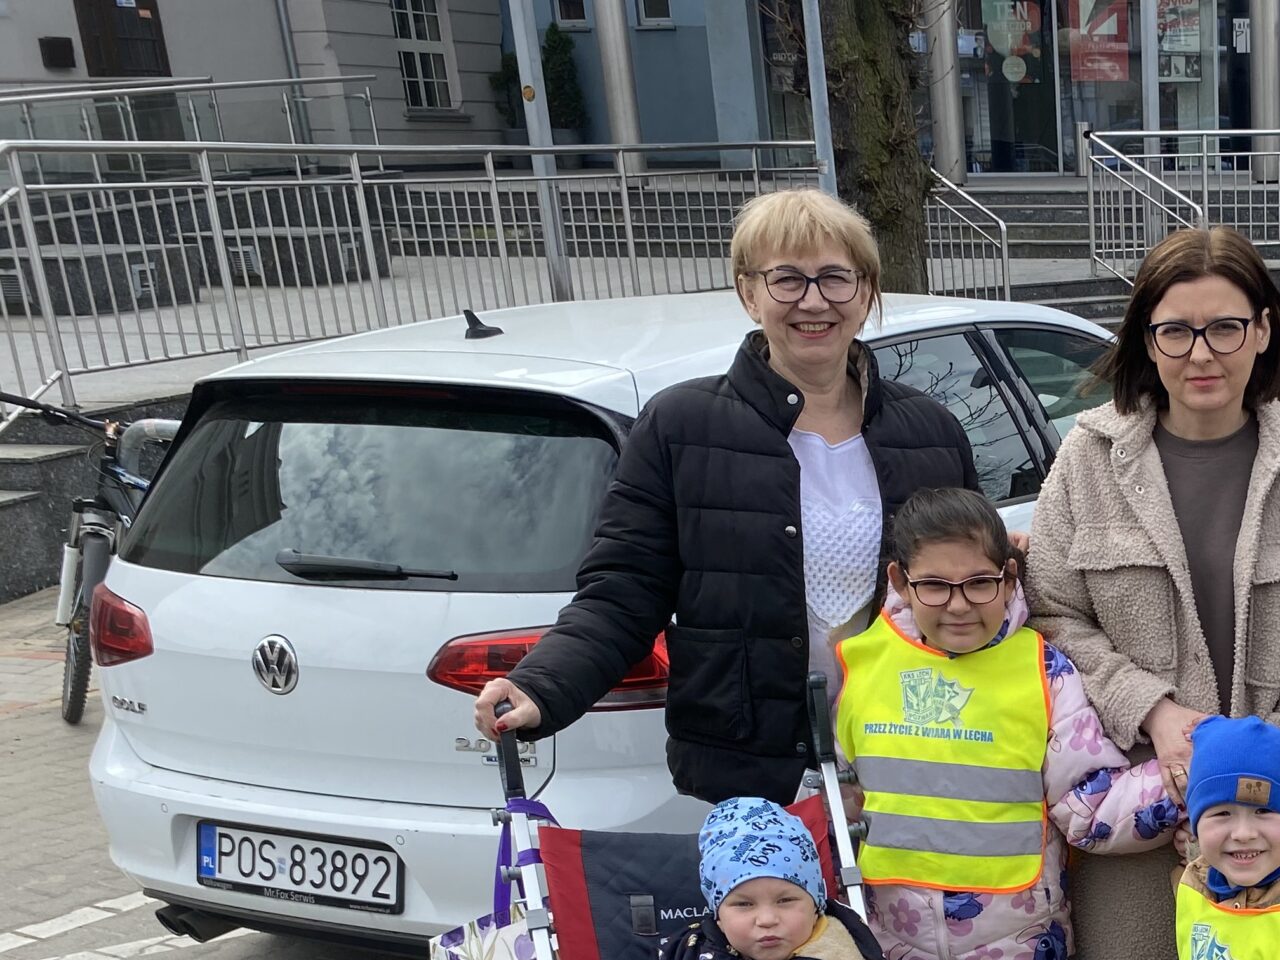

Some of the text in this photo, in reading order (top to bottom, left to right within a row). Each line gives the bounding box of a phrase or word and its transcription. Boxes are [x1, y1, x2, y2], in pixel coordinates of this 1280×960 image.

[993, 1, 1028, 20] TEN
[112, 696, 147, 714] GOLF
[864, 723, 887, 734] PRZEZ
[888, 721, 912, 736] ŻYCIE
[914, 726, 920, 736] Z
[953, 729, 962, 739] W
[964, 730, 994, 742] LECHA
[455, 738, 491, 753] 2.0
[203, 855, 215, 868] PL
[218, 832, 391, 900] POS 83892
[660, 906, 710, 920] MACLA
